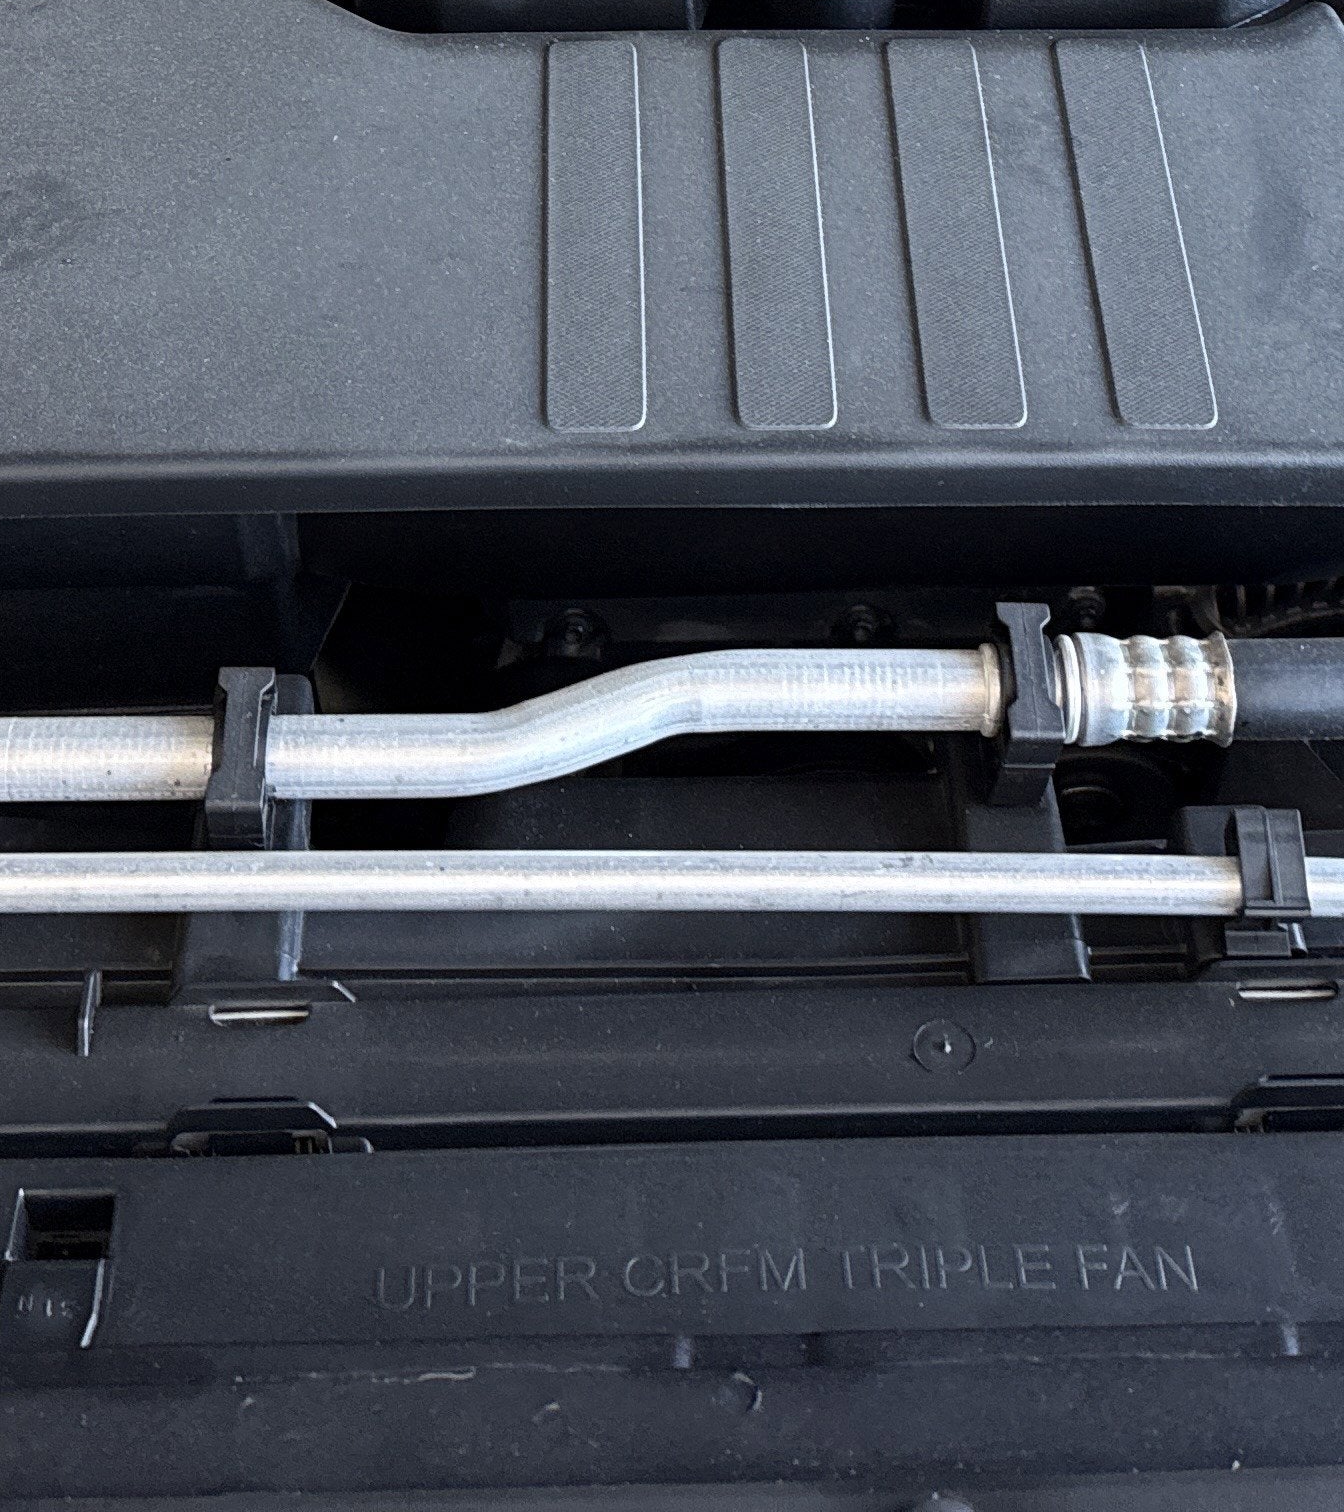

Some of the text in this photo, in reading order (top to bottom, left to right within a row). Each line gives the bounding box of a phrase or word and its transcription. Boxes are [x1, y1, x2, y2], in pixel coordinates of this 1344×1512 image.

[376, 1254, 602, 1311] UPPER
[832, 1242, 1058, 1292] TRIPLE
[1075, 1242, 1200, 1293] FAN
